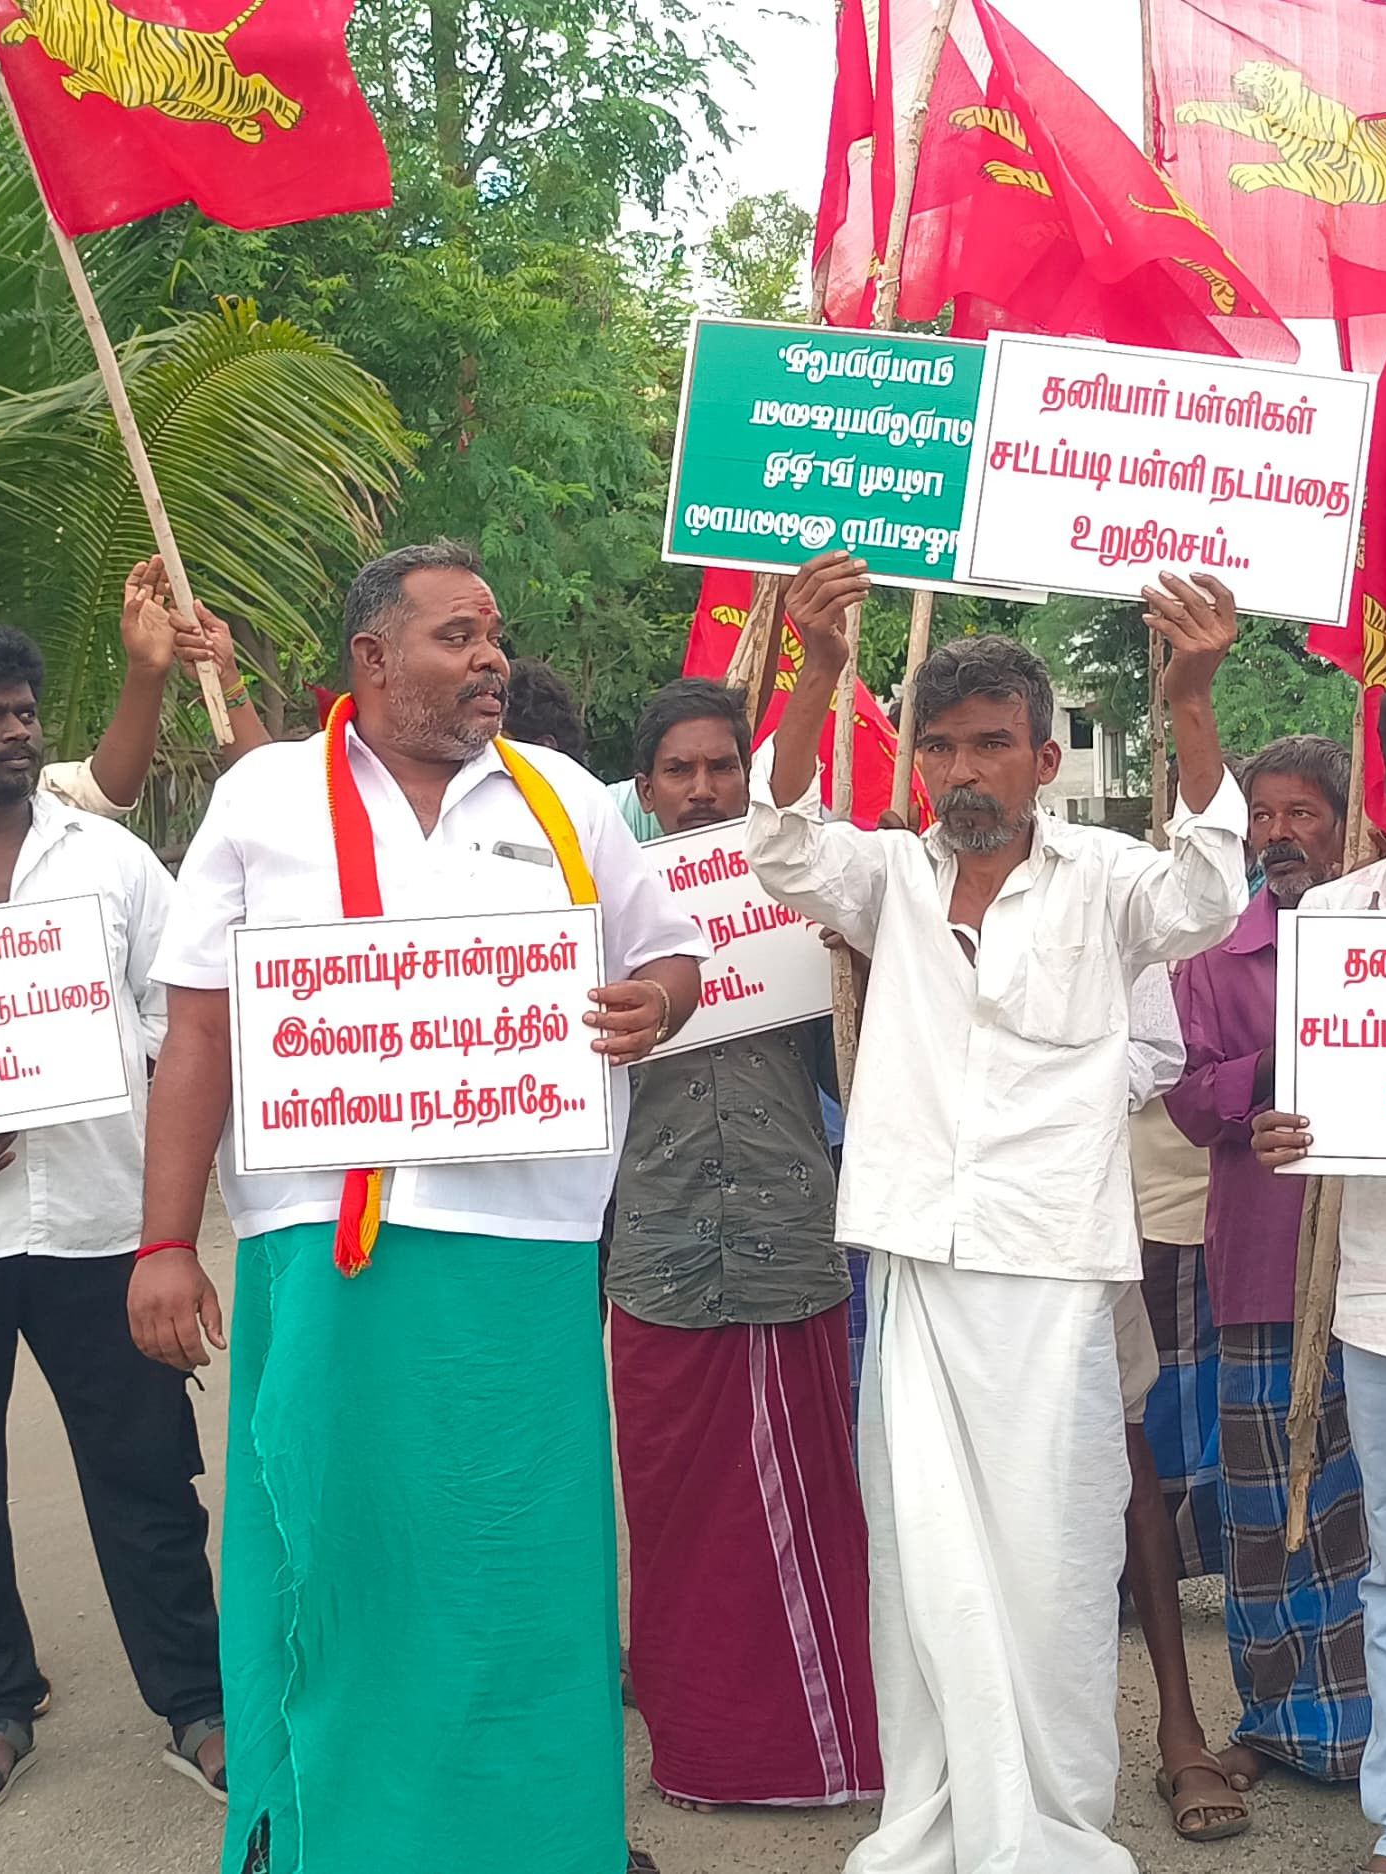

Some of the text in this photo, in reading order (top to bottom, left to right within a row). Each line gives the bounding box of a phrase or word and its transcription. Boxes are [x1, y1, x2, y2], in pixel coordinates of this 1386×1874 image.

[778, 340, 955, 388] ஏமாற்றாதே.
[749, 400, 974, 448] பெற்றோர்களை
[1041, 373, 1316, 434] தனியார் பள்ளிகள்
[763, 449, 943, 501] பள்ளி நடத்தி
[990, 439, 1349, 517] சட்டப்படி பள்ளி நடப்பதை
[685, 505, 835, 548] இல்லாமல்
[1071, 515, 1249, 570] உறுதிசெய்...
[667, 848, 750, 893] ள்ளிக
[255, 931, 578, 1001] பாதுகாப்புச்சான்றுகள்
[273, 1003, 568, 1061] இல்லாத கட்டிடத்தில்
[262, 1074, 585, 1130] பள்ளியை நடத்தாதே...
